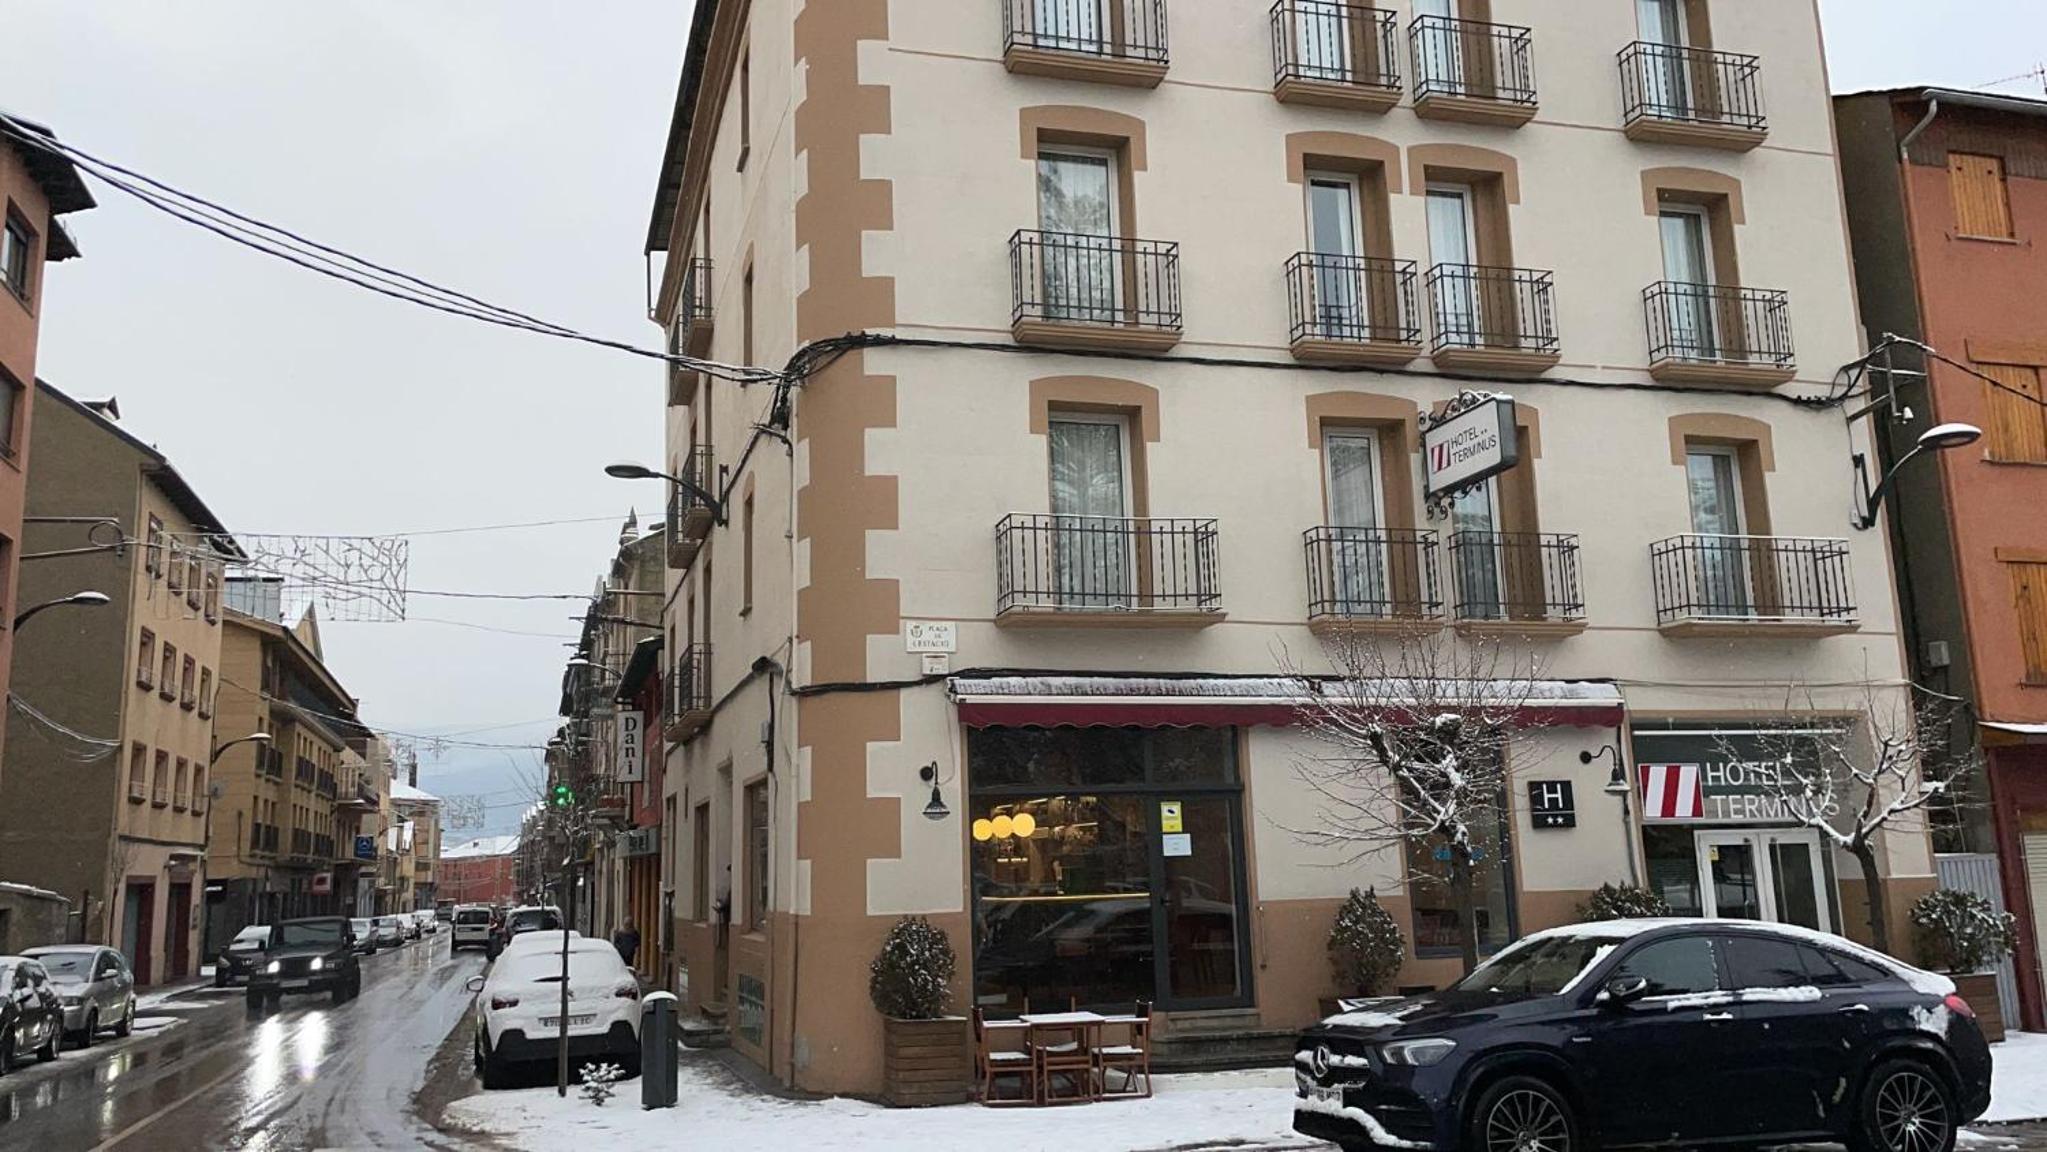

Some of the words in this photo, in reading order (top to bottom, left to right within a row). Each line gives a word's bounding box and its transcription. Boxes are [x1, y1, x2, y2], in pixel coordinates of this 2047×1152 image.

[1450, 426, 1479, 450] HOTEL
[1452, 434, 1497, 464] TERMINUS
[624, 716, 637, 775] Dani
[1706, 761, 1792, 787] HOTEL
[1542, 783, 1564, 809] H
